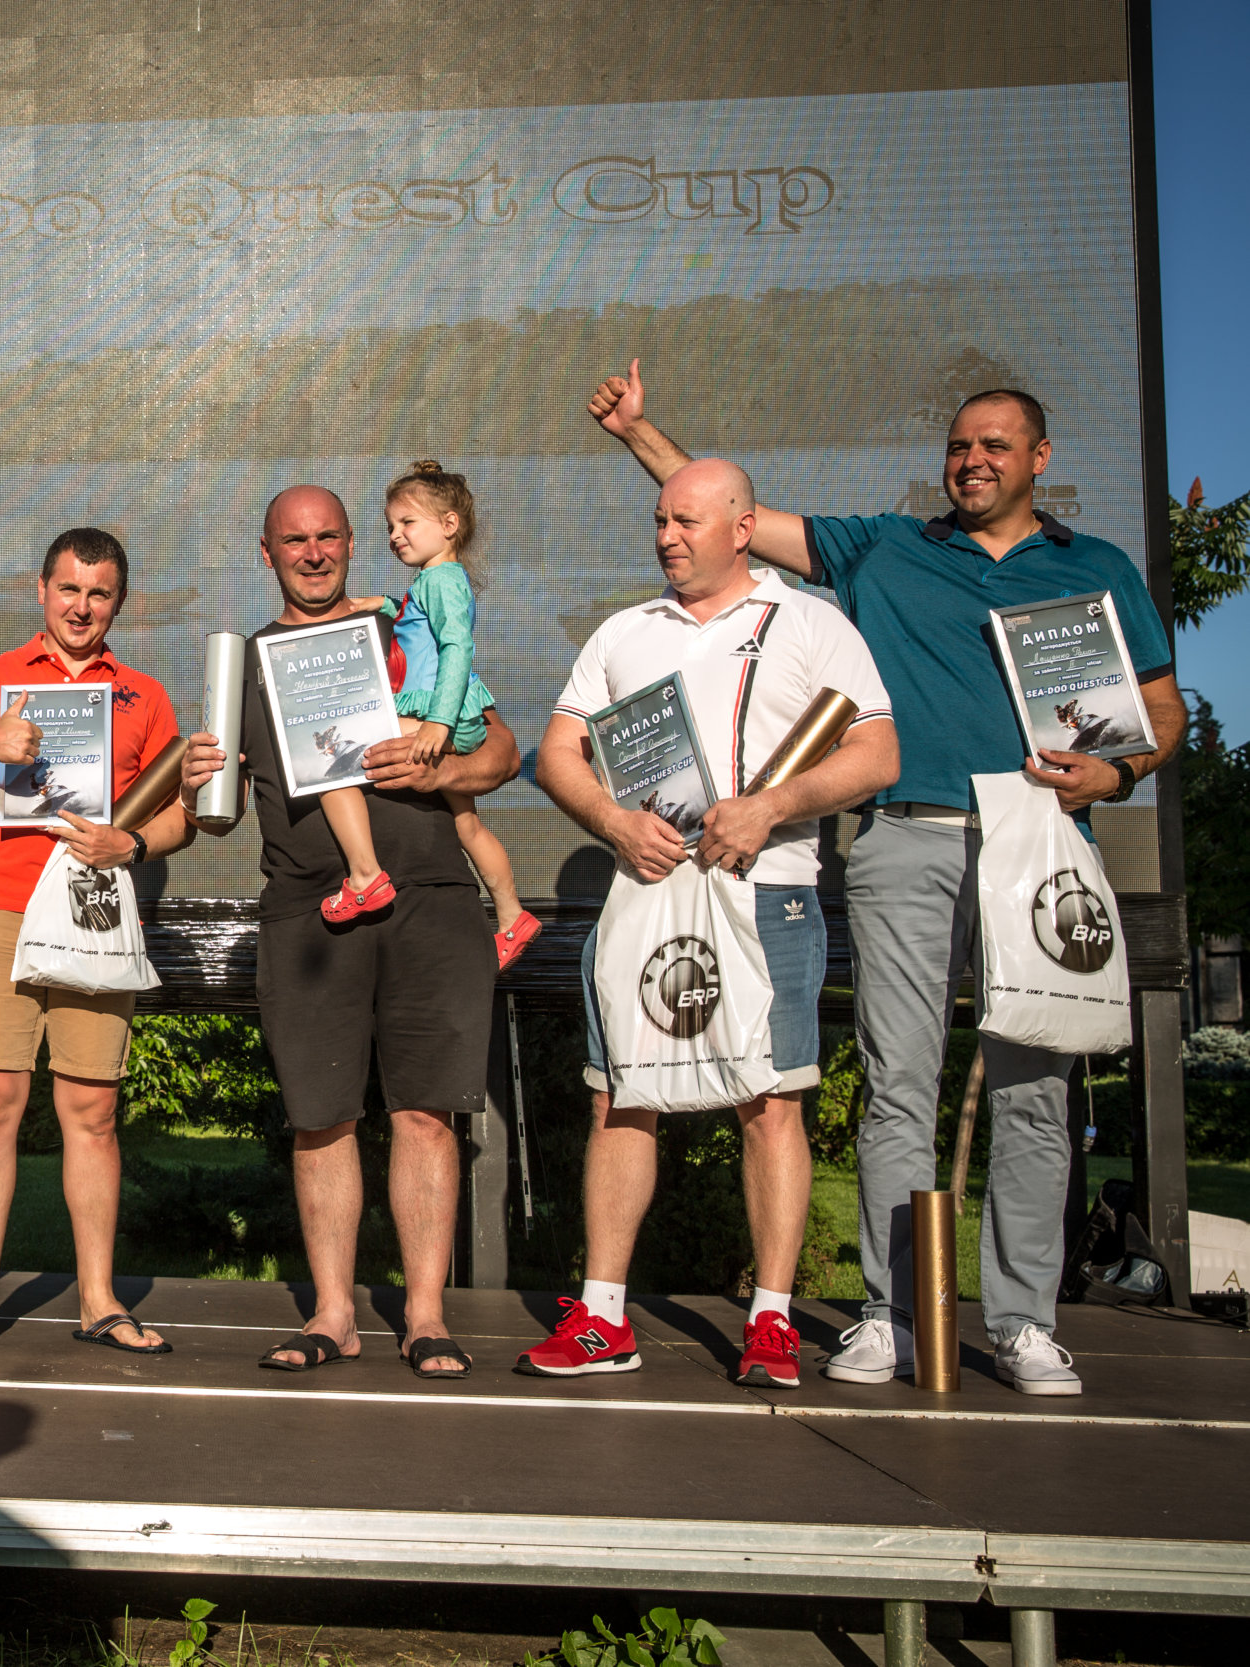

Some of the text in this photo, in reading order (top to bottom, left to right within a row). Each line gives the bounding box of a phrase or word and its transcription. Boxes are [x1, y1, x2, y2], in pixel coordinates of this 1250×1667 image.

[140, 163, 519, 243] Quest
[552, 154, 835, 235] Cup
[1022, 621, 1100, 647] ДИПЛОМ
[286, 648, 363, 675] ДИПЛОМ
[1025, 674, 1123, 699] SEA-DOO QUEST CUP
[20, 707, 94, 720] ДИПЛОМ
[286, 700, 382, 726] SEA-DOO QUEST CUP
[612, 705, 675, 747] ДИПЛОМ
[49, 755, 80, 765] QUEST
[80, 754, 101, 764] CUP
[616, 777, 650, 799] SEA-DOO
[650, 764, 677, 783] QUEST
[677, 755, 695, 770] CUP
[785, 913, 806, 921] adidas
[677, 987, 719, 1008] BRP
[574, 1328, 610, 1356] N
